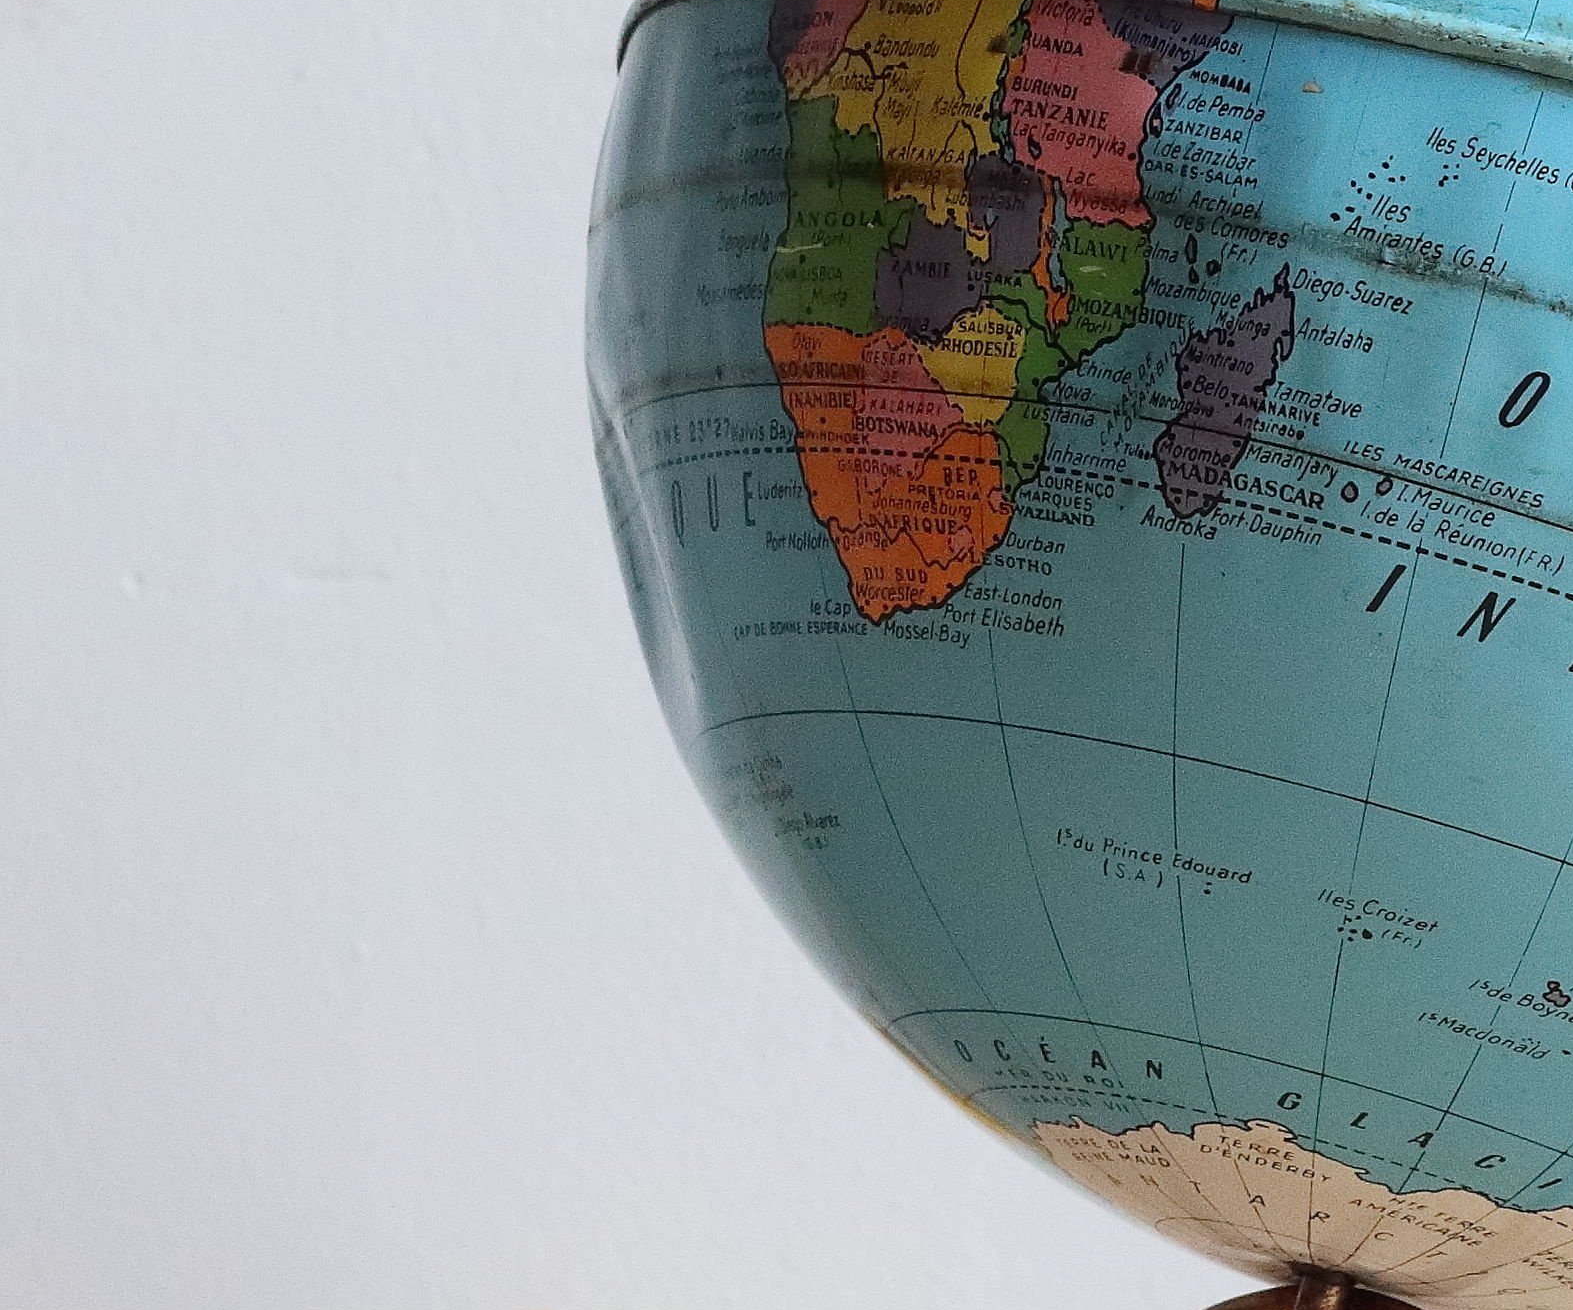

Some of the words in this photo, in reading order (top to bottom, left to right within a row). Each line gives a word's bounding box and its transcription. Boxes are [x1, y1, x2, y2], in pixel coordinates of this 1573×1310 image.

[1011, 97, 1109, 130] TANZANIE
[1164, 118, 1243, 143] ZANZIBAR
[1461, 136, 1560, 183] Seychelles
[1344, 218, 1444, 260] Amirantes
[1293, 268, 1413, 315] Diego-Suarez
[1297, 317, 1374, 353] Antalaha
[1272, 381, 1362, 418] Tamatave
[1167, 462, 1325, 511] MADAGASCAR
[1343, 440, 1382, 461] ILES
[1394, 453, 1545, 509] MASCAREIGNES
[1019, 488, 1093, 512] MARQUES
[1139, 505, 1217, 542] Androka
[1006, 531, 1066, 555] Durban
[943, 602, 976, 621] Port
[980, 607, 1064, 637] Elisabeth
[1102, 838, 1162, 865] Prince
[1172, 852, 1253, 884] Edouard
[1362, 900, 1438, 933] Croizet
